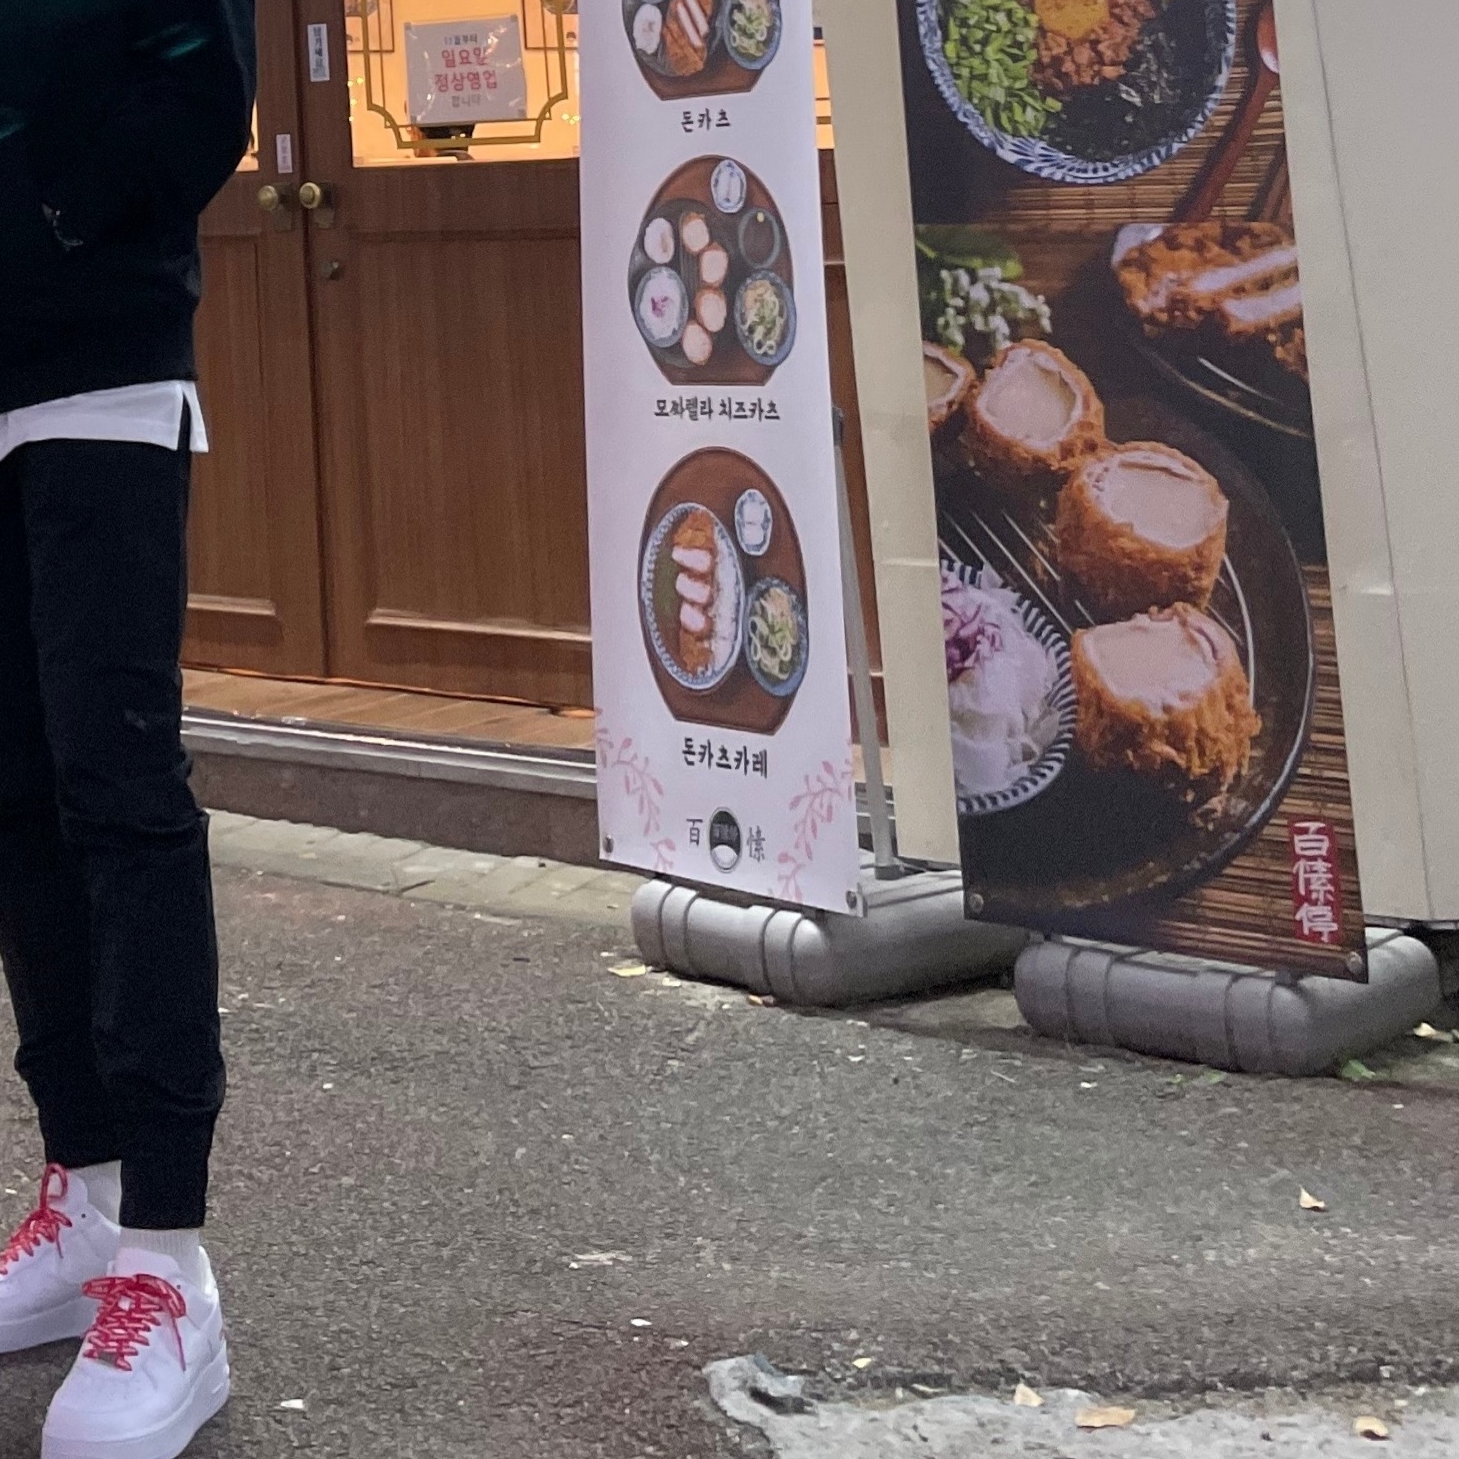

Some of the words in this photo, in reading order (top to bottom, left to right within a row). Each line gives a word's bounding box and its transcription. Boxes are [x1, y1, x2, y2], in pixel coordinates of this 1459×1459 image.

[680, 107, 731, 134] 돈카츠
[719, 396, 780, 422] 치즈카츠
[682, 736, 768, 780] 돈카츠카레
[685, 818, 704, 847] 百
